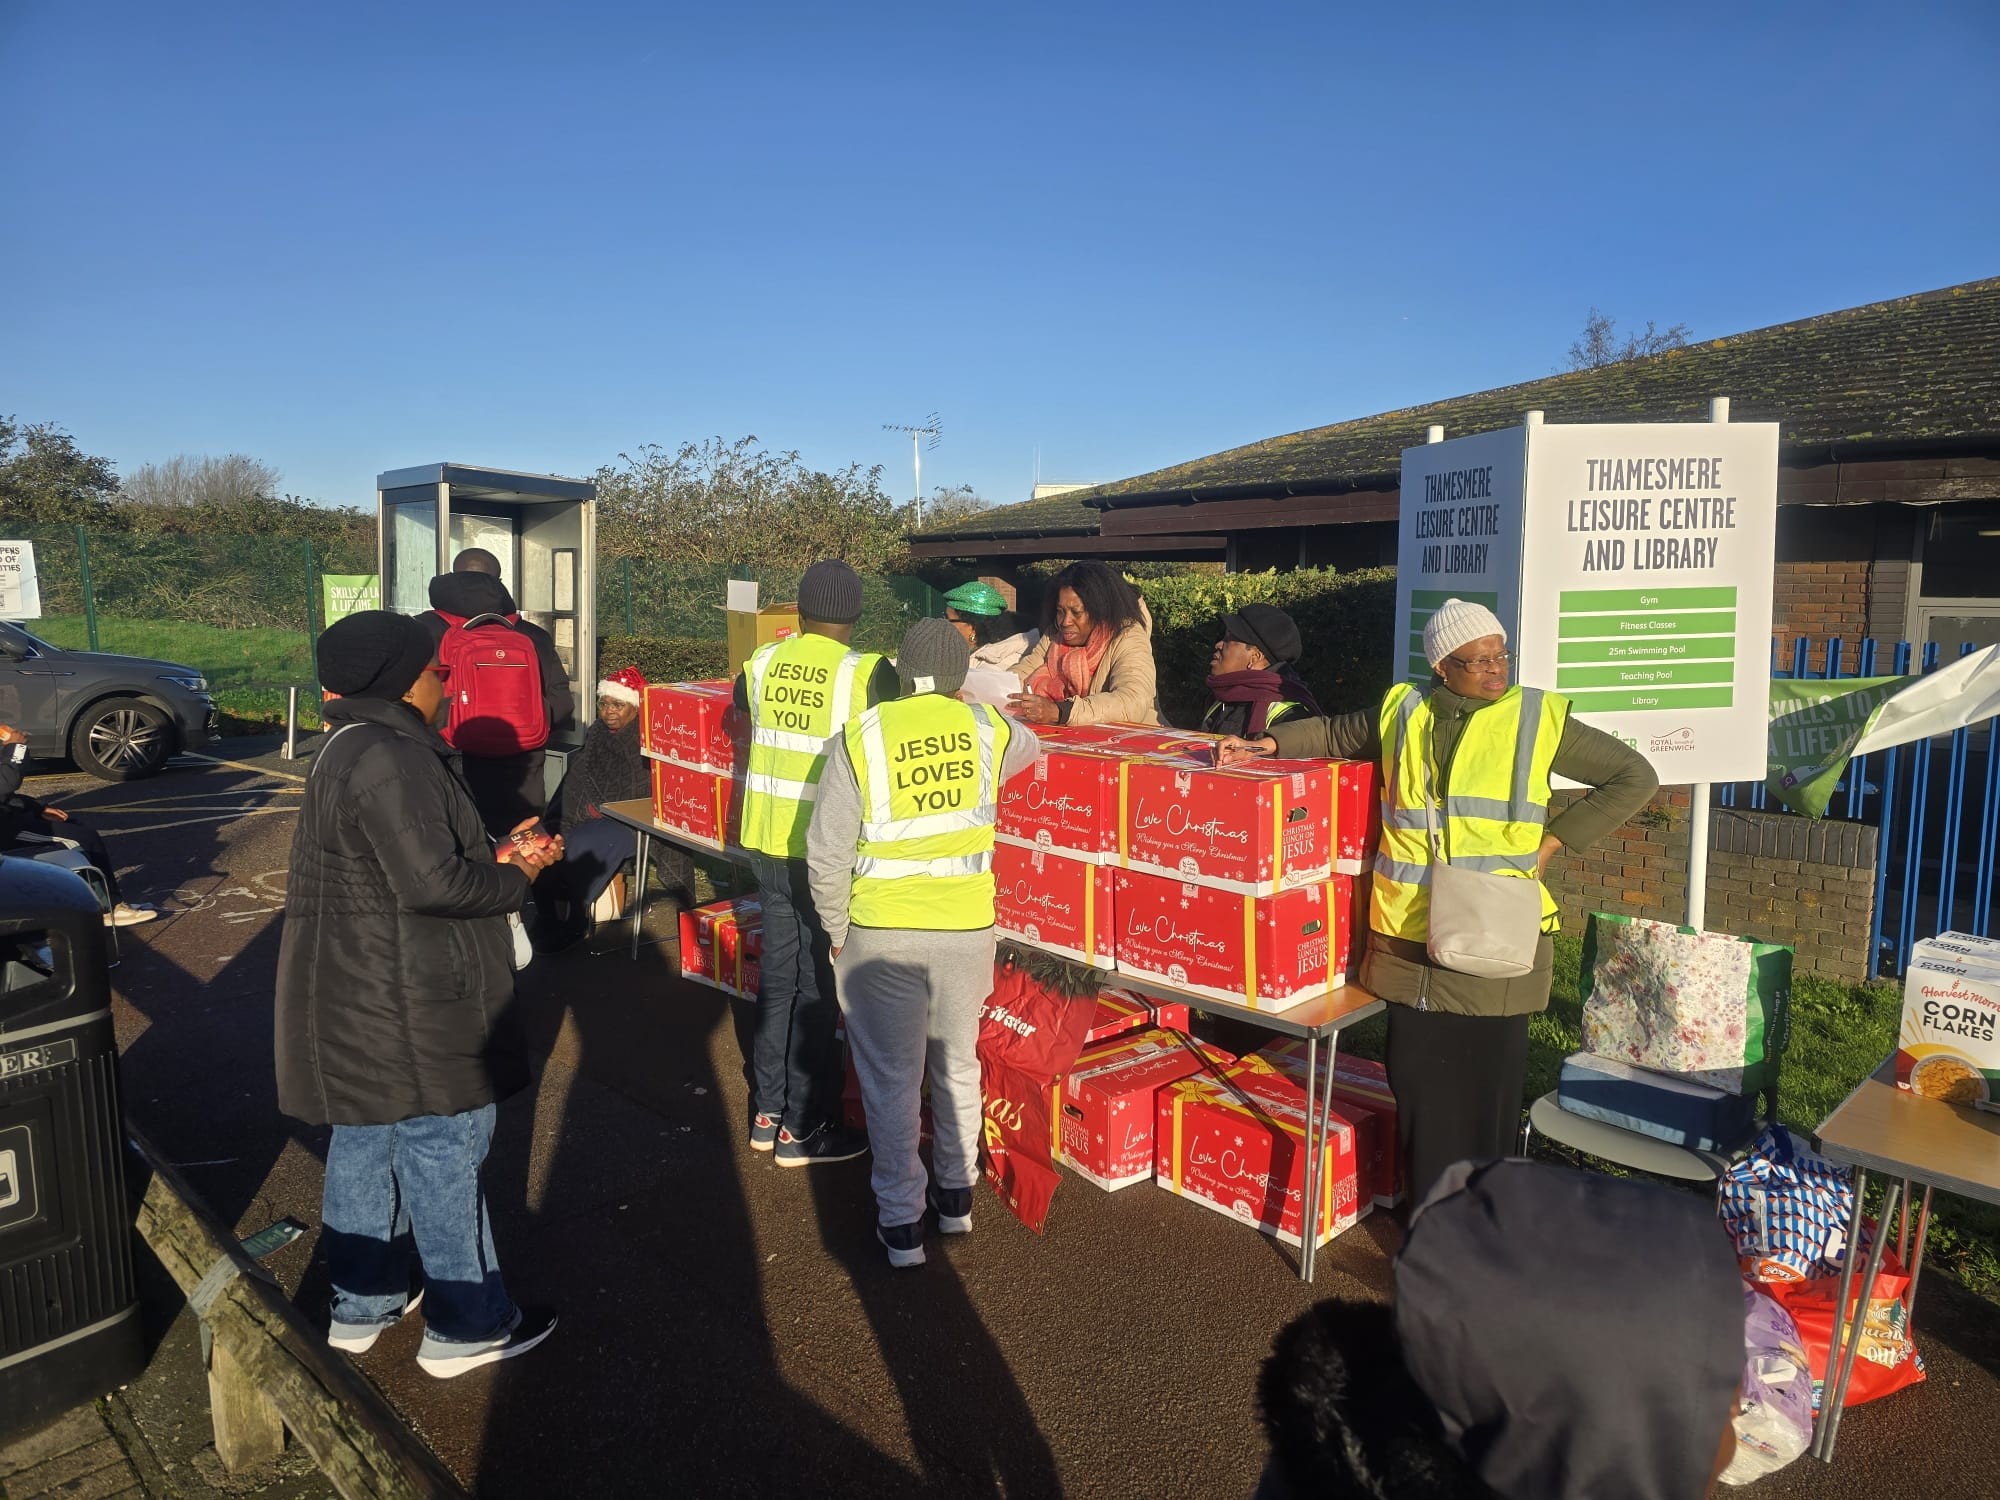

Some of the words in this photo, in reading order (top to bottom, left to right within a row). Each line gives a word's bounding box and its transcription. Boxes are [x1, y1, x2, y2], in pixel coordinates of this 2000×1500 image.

[1425, 465, 1493, 503] THAMESMERE
[1587, 457, 1723, 491] THAMESMERE
[1415, 508, 1455, 539] LEISURE
[1458, 503, 1500, 537] CENTRE
[1567, 498, 1652, 532] LEISURE
[1659, 497, 1737, 530] CENTRE
[1421, 545, 1441, 574] AND
[1444, 543, 1489, 574] LIBRARY
[1582, 539, 1626, 572] AND
[1633, 537, 1719, 570] LIBRARY
[330, 586, 358, 599] SKILLS
[1640, 596, 1659, 606] Gym
[1620, 621, 1648, 631] Fitness
[1649, 620, 1677, 630] Classes
[1608, 647, 1626, 656] 25m
[1628, 646, 1668, 656] Swimming
[1669, 645, 1686, 653] Pool
[768, 662, 829, 685] JESUS
[1620, 671, 1655, 681] Teaching
[1656, 670, 1673, 679] Pool
[764, 685, 825, 709] LOVES
[1632, 696, 1659, 706] Library
[1841, 690, 1873, 720] TO
[773, 709, 811, 732] YOU
[894, 732, 973, 763] JESUS
[1650, 745, 1695, 753] GREENWICH
[896, 759, 975, 790] LOVES
[912, 788, 962, 813] YOU
[1001, 782, 1023, 804] Love
[1026, 781, 1093, 818] Christmas
[1135, 796, 1162, 829] Love
[1166, 804, 1249, 845] Christmas
[1282, 822, 1316, 837] CHRISTMAS
[1136, 832, 1162, 848] Wishing
[1162, 841, 1174, 850] you
[1180, 841, 1207, 858] Merry
[1208, 845, 1248, 862] Christmas!
[1281, 838, 1315, 865] JESUS
[1282, 832, 1305, 845] LUNCH
[1305, 830, 1315, 840] ON
[1015, 879, 1071, 914] Christmas
[1128, 907, 1152, 936] Love
[1155, 915, 1226, 953] Christmas
[1124, 937, 1151, 954] Wishing
[1151, 947, 1163, 957] you
[1168, 948, 1194, 966] Merry
[1195, 953, 1235, 973] Christmas!
[1297, 950, 1329, 980] JESUS
[1920, 985, 1969, 1001] Harvest
[989, 1005, 1037, 1039] Water
[1922, 1015, 1994, 1042] FLAKES
[1923, 1000, 1996, 1030] CORN
[1060, 1127, 1089, 1155] JESUS
[1124, 1123, 1147, 1150] Love
[1190, 1135, 1216, 1165] Love
[1221, 1150, 1302, 1202] Christmas
[1190, 1166, 1217, 1187] Wishing
[1235, 1186, 1261, 1205] Merry
